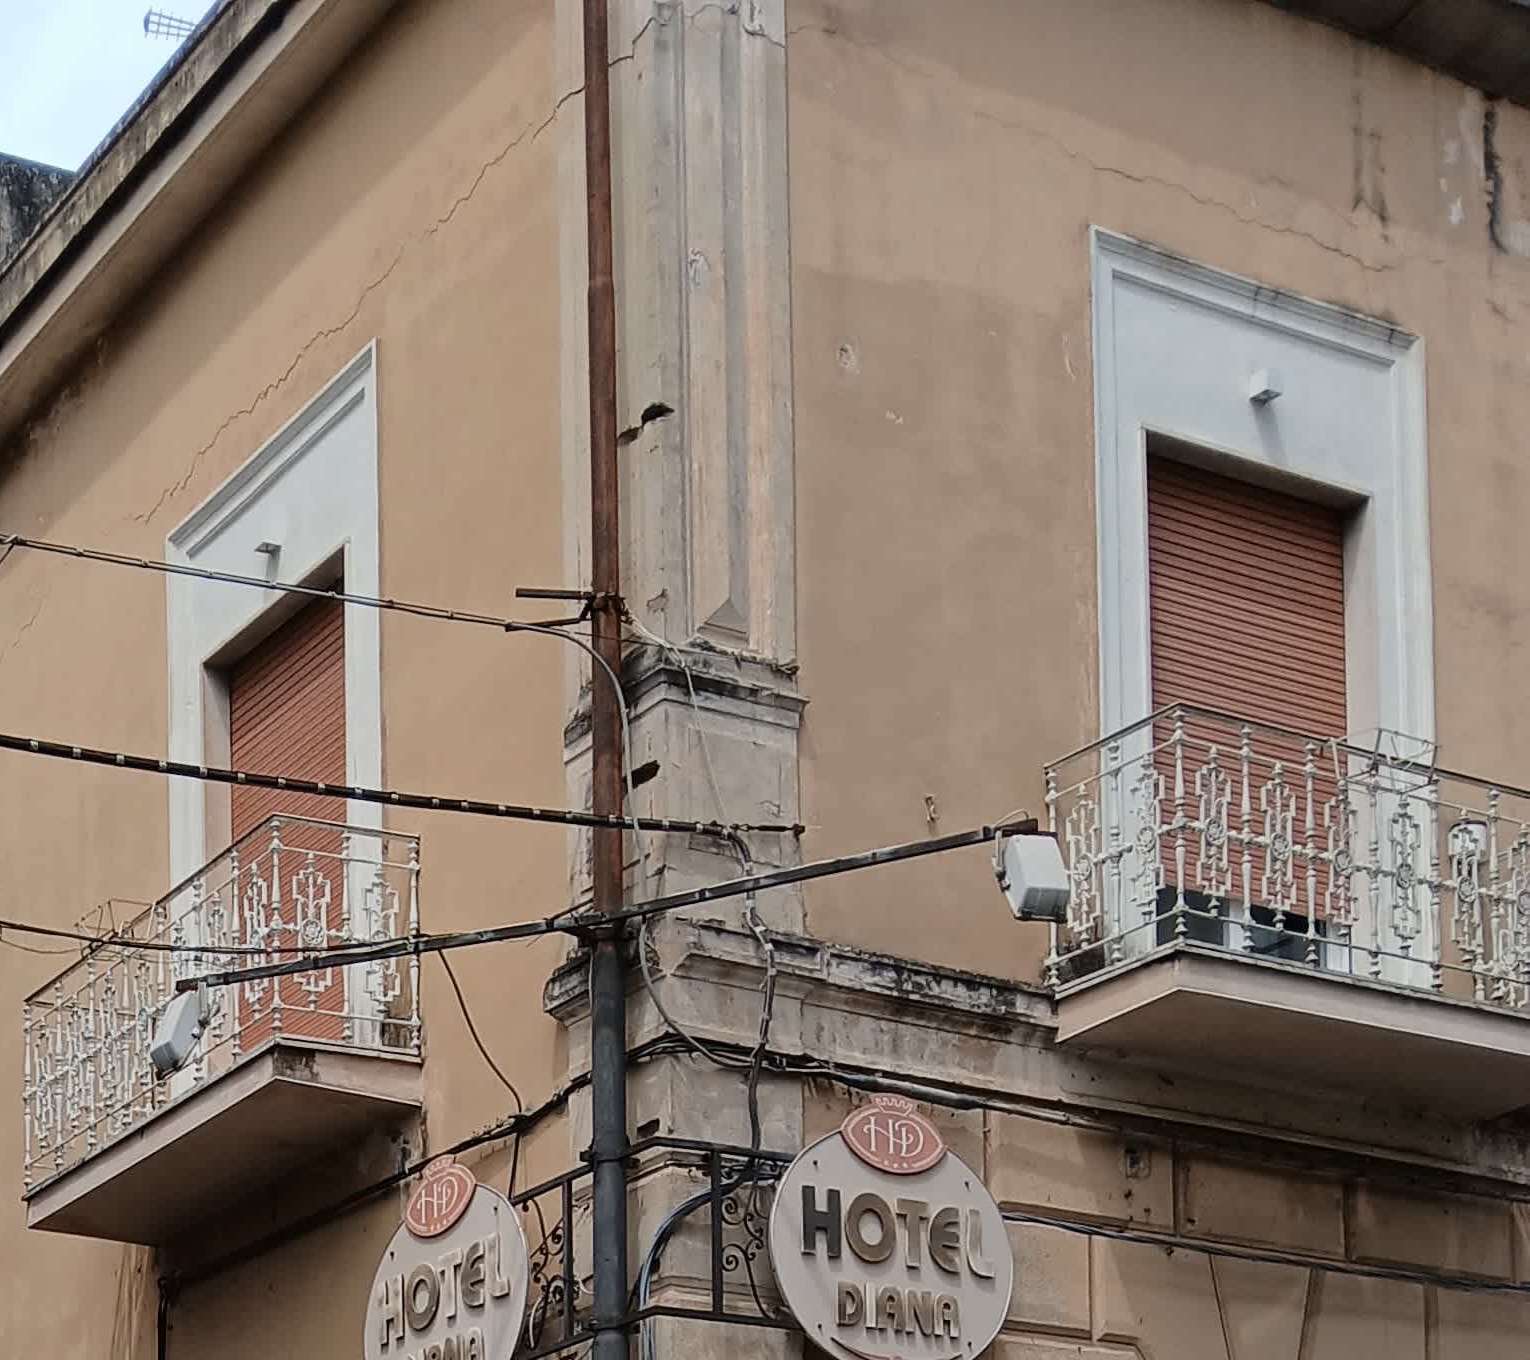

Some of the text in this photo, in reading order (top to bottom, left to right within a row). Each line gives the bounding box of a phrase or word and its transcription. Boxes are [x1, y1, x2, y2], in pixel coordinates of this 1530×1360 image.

[801, 1185, 995, 1279] HOTEL
[379, 1231, 510, 1346] HOTEL
[836, 1281, 960, 1338] DIANA
